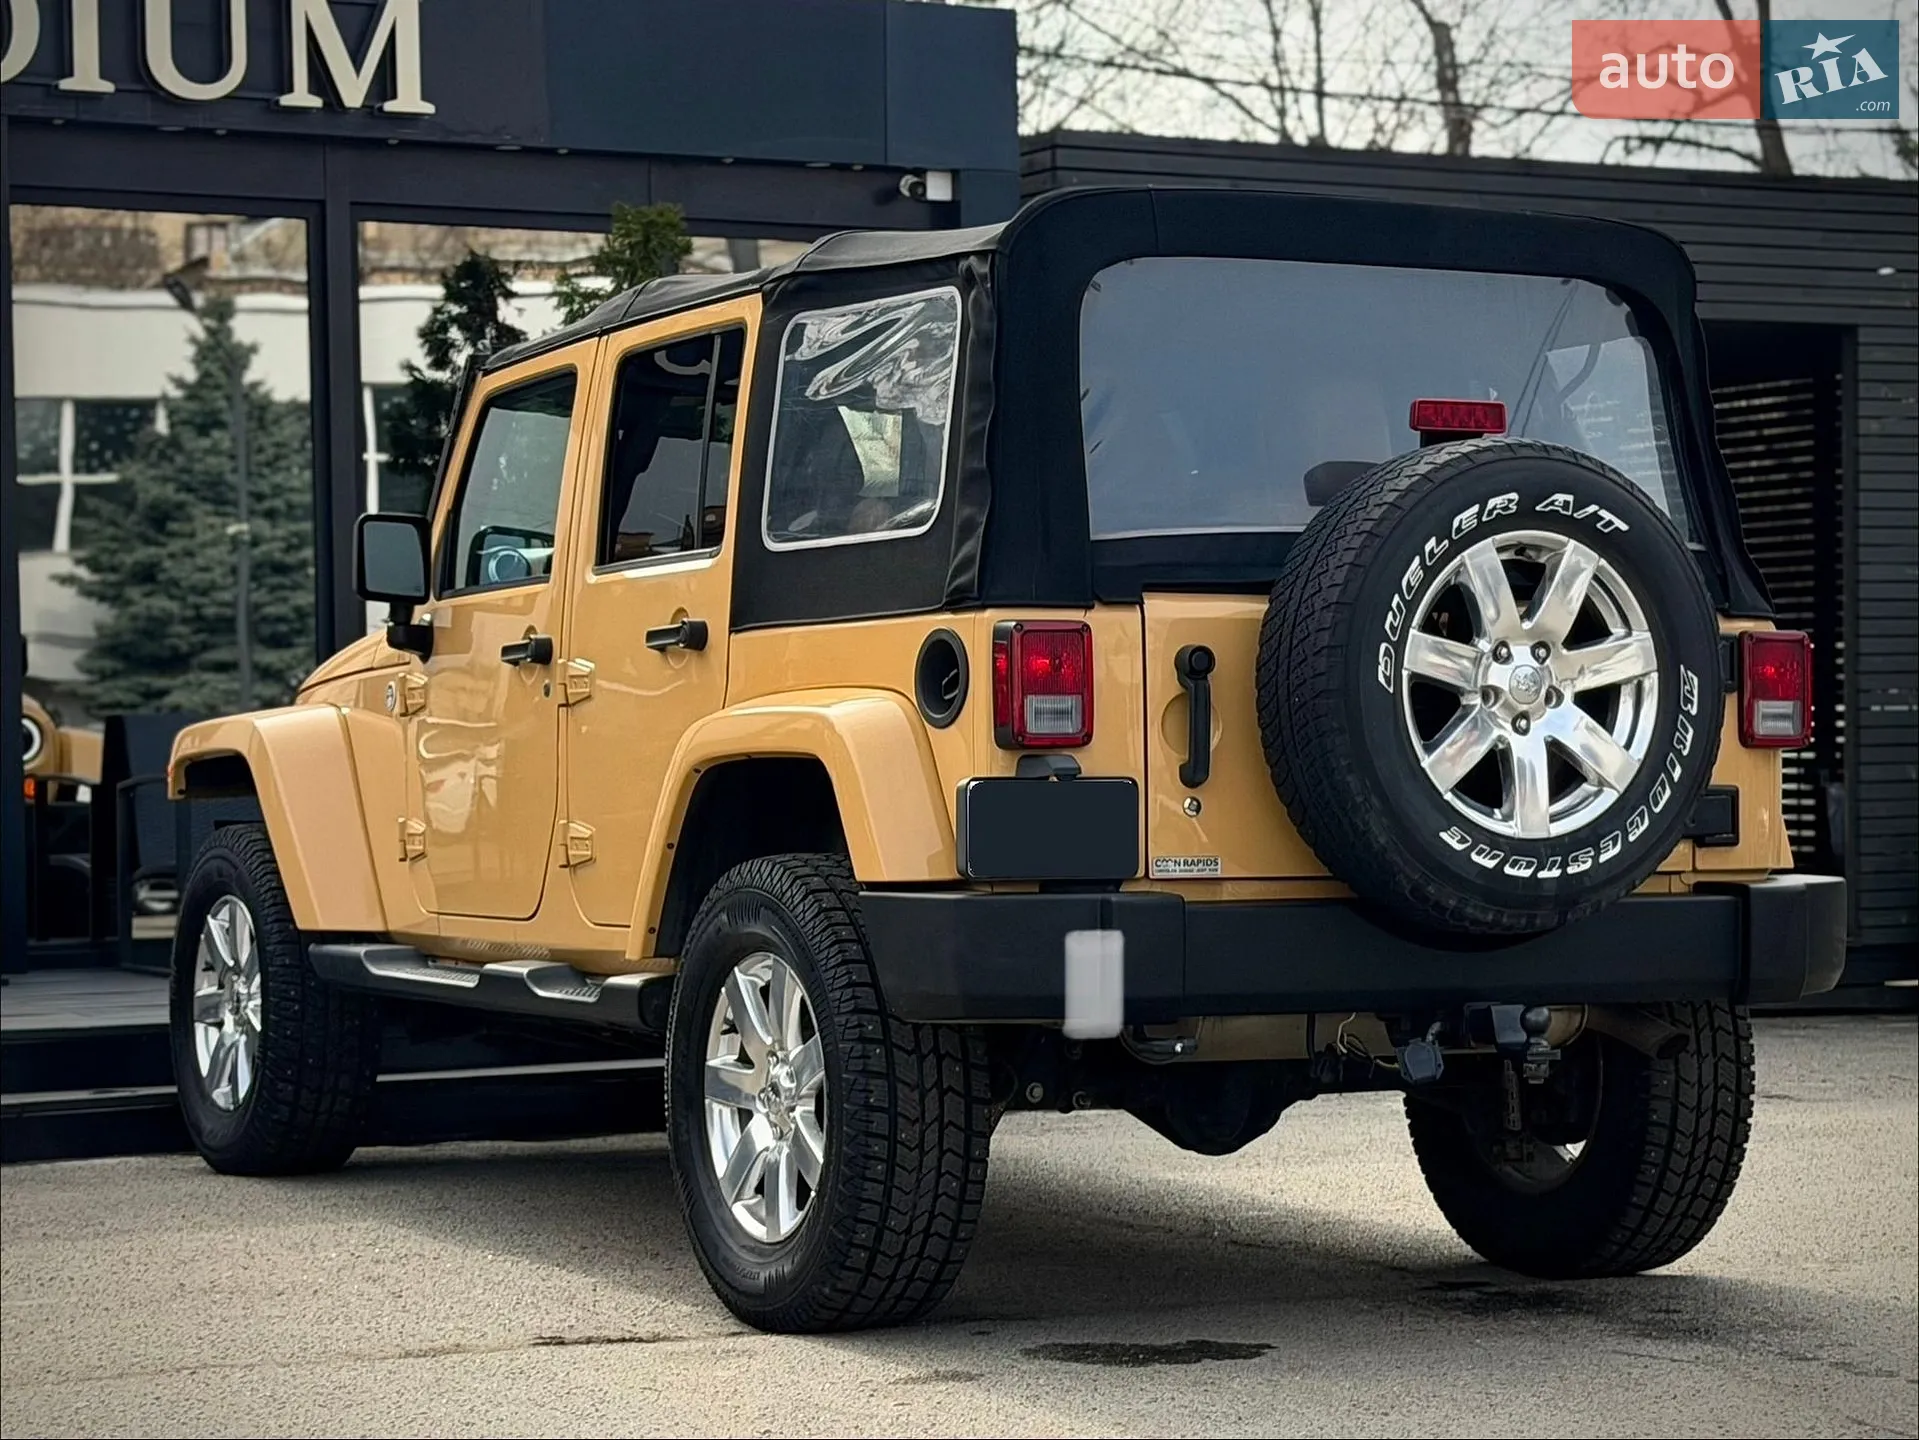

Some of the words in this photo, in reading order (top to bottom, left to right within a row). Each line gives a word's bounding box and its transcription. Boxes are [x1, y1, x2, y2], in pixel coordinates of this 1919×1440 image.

[1378, 492, 1519, 693] DUELER
[1535, 493, 1629, 533] A/T
[1183, 857, 1219, 867] RAPIDS
[1439, 664, 1698, 878] BRIDGESTONE
